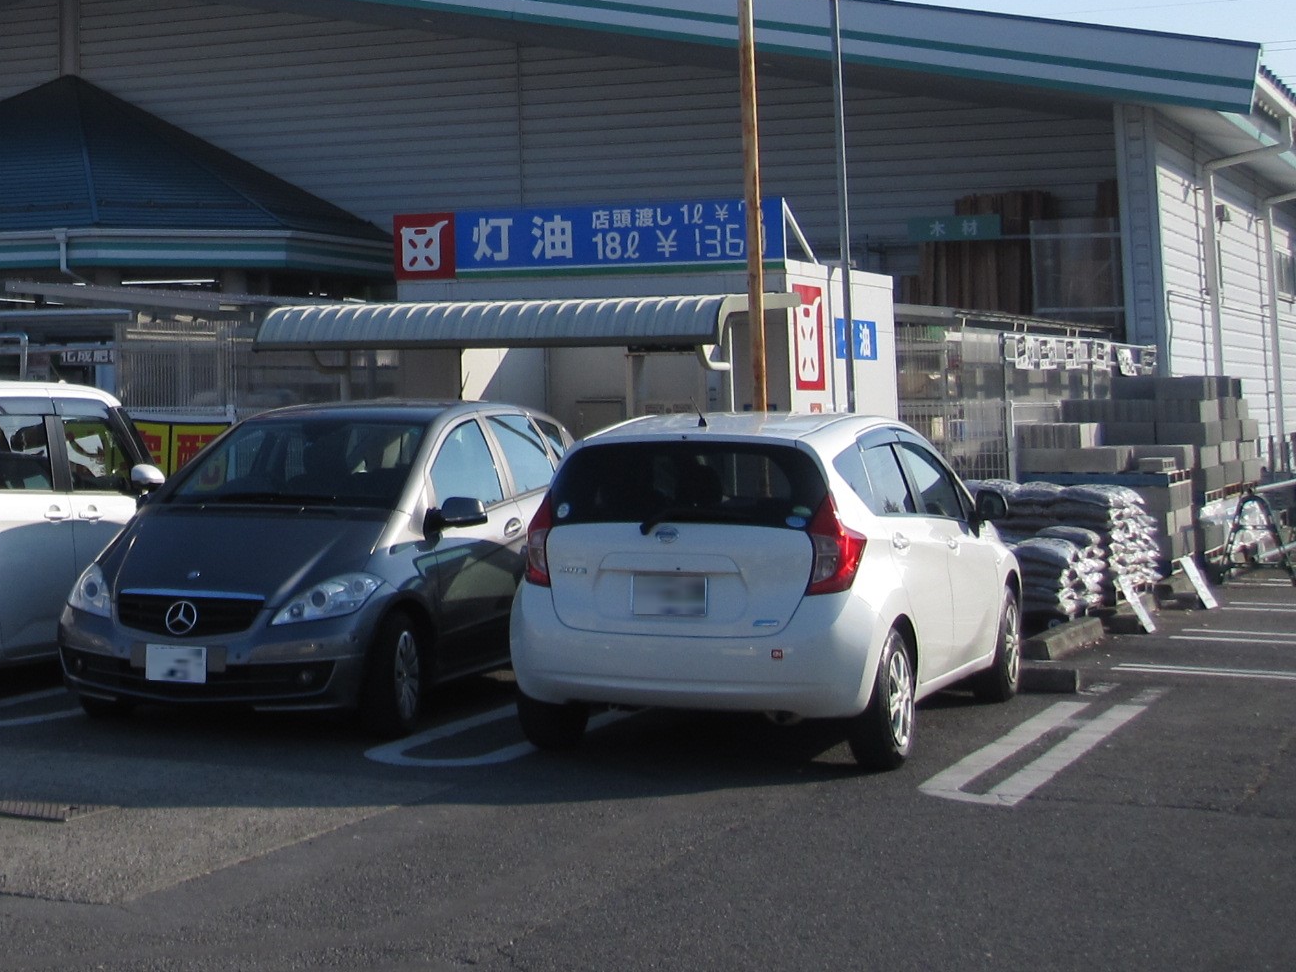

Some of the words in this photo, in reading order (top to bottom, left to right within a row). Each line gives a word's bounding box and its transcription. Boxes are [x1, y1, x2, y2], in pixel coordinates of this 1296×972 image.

[592, 208, 672, 229] 店頭渡し
[929, 220, 978, 237] 木材
[472, 215, 574, 262] 灯油
